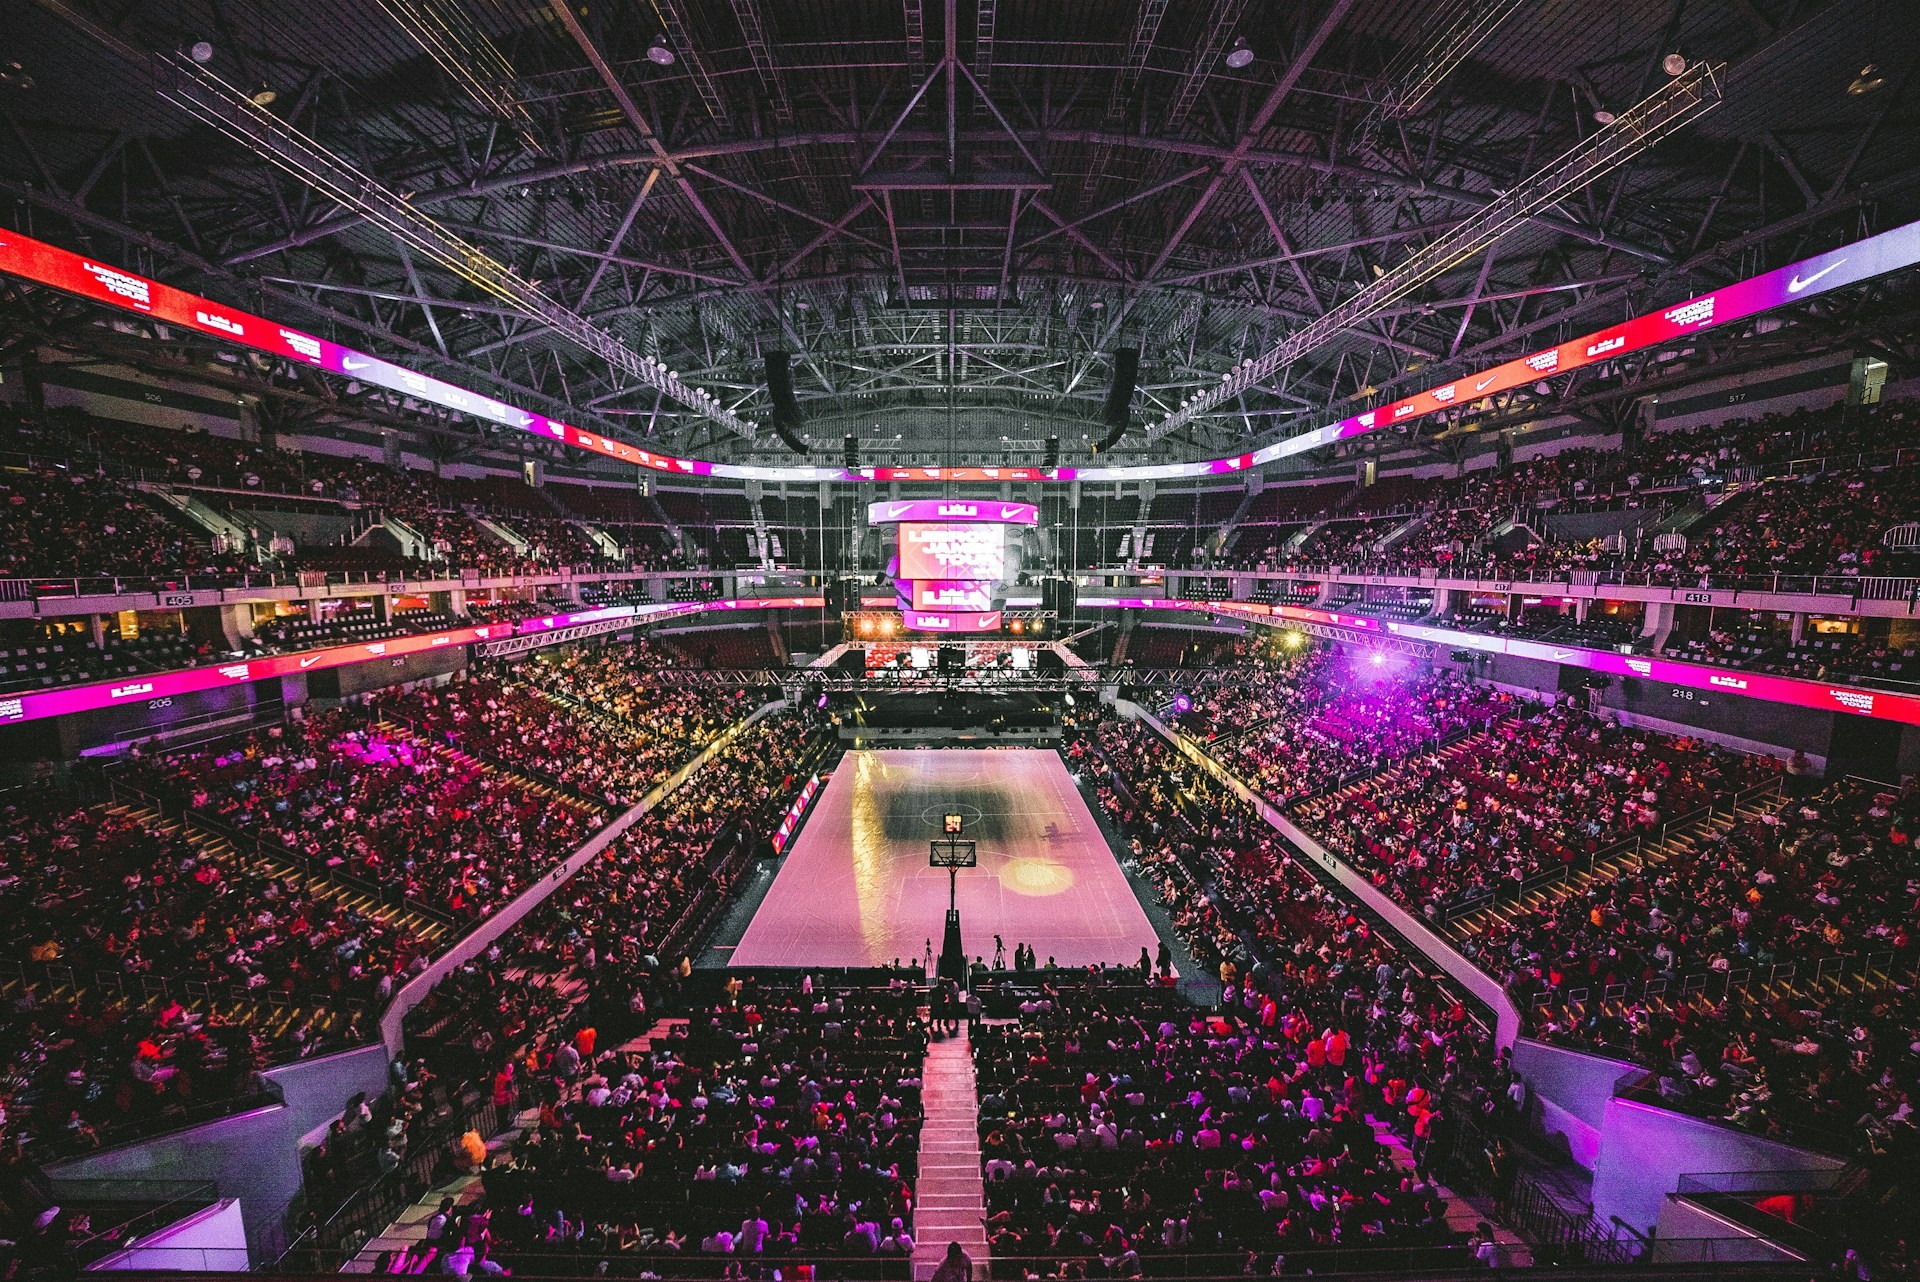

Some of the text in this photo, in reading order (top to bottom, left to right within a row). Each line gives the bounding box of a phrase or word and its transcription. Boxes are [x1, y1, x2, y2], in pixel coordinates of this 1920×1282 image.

[105, 283, 150, 303] TOUR
[1678, 310, 1713, 326] TOUR
[1729, 393, 1746, 403] 517
[168, 596, 192, 605] 405
[1687, 593, 1709, 603] 418
[1672, 689, 1694, 700] 218
[148, 698, 173, 709] 205
[1842, 701, 1873, 709] TOUR
